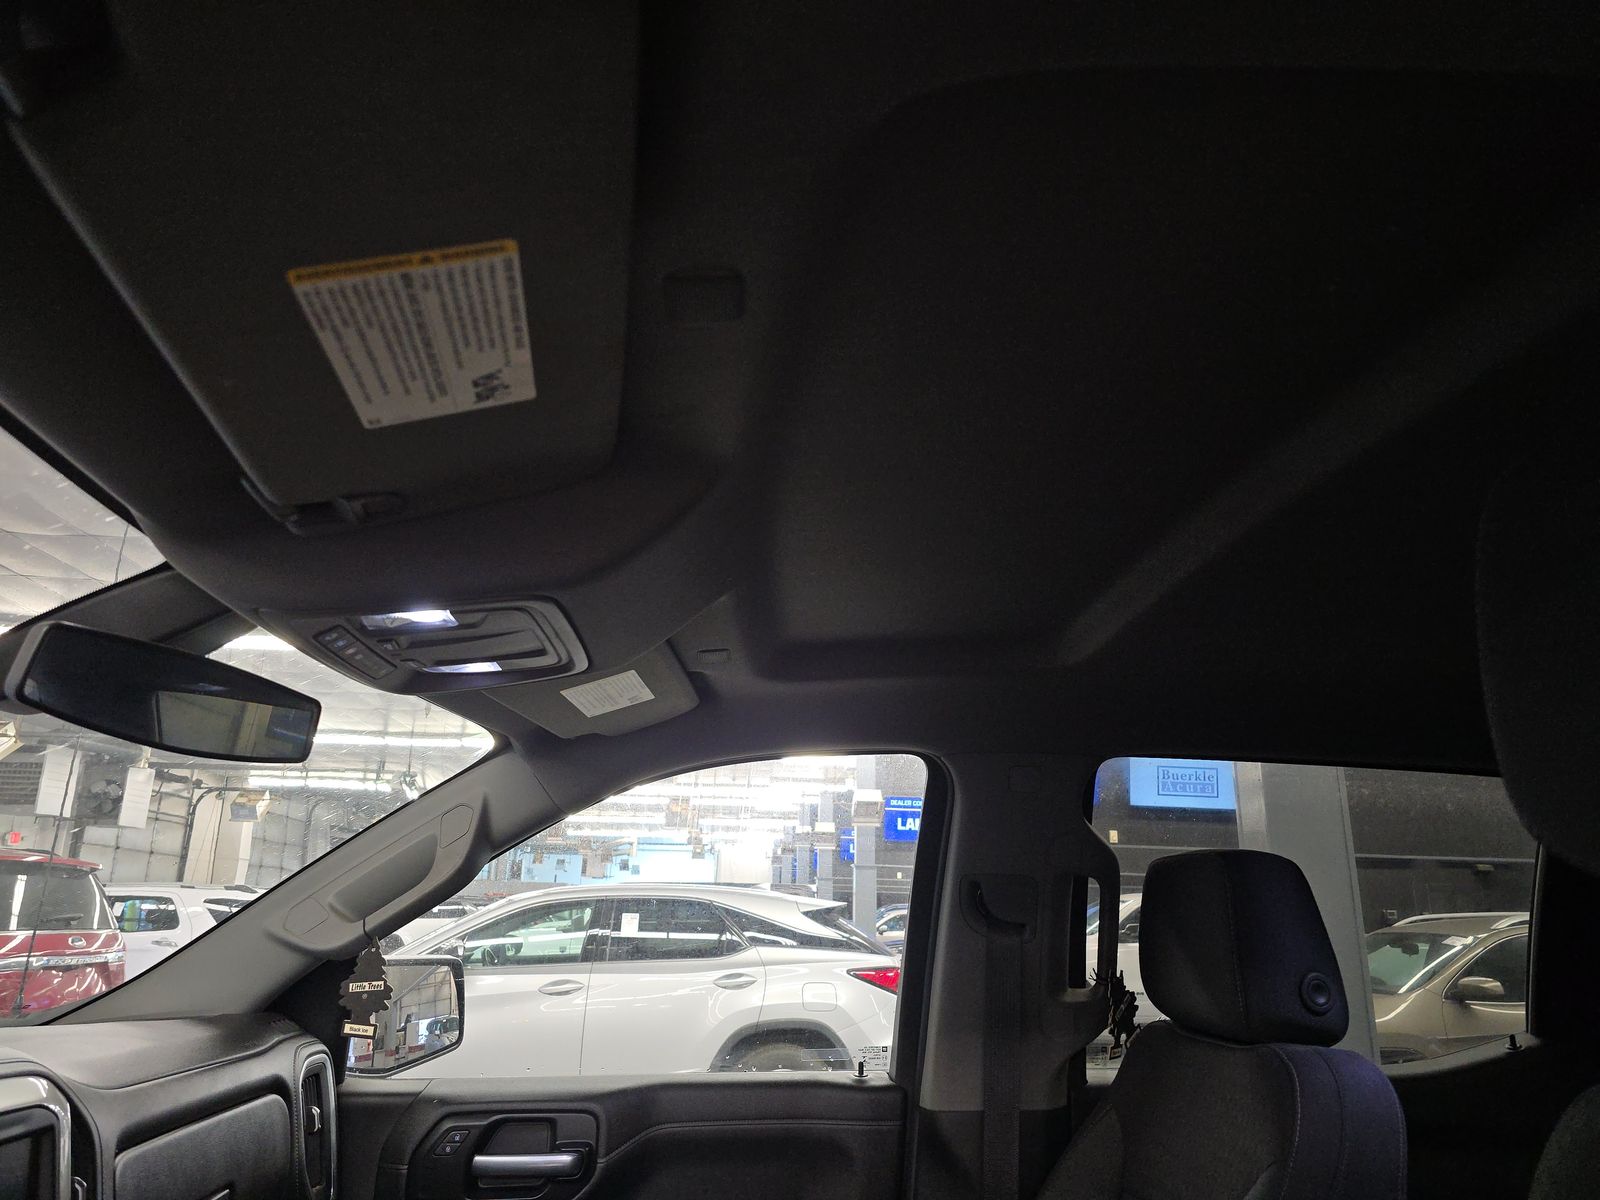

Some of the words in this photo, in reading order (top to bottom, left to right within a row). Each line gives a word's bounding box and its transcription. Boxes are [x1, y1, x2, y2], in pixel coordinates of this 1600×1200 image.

[1161, 768, 1215, 782] Buerkle
[1164, 781, 1212, 793] Acura
[351, 983, 366, 991] Little
[367, 982, 383, 990] Trees
